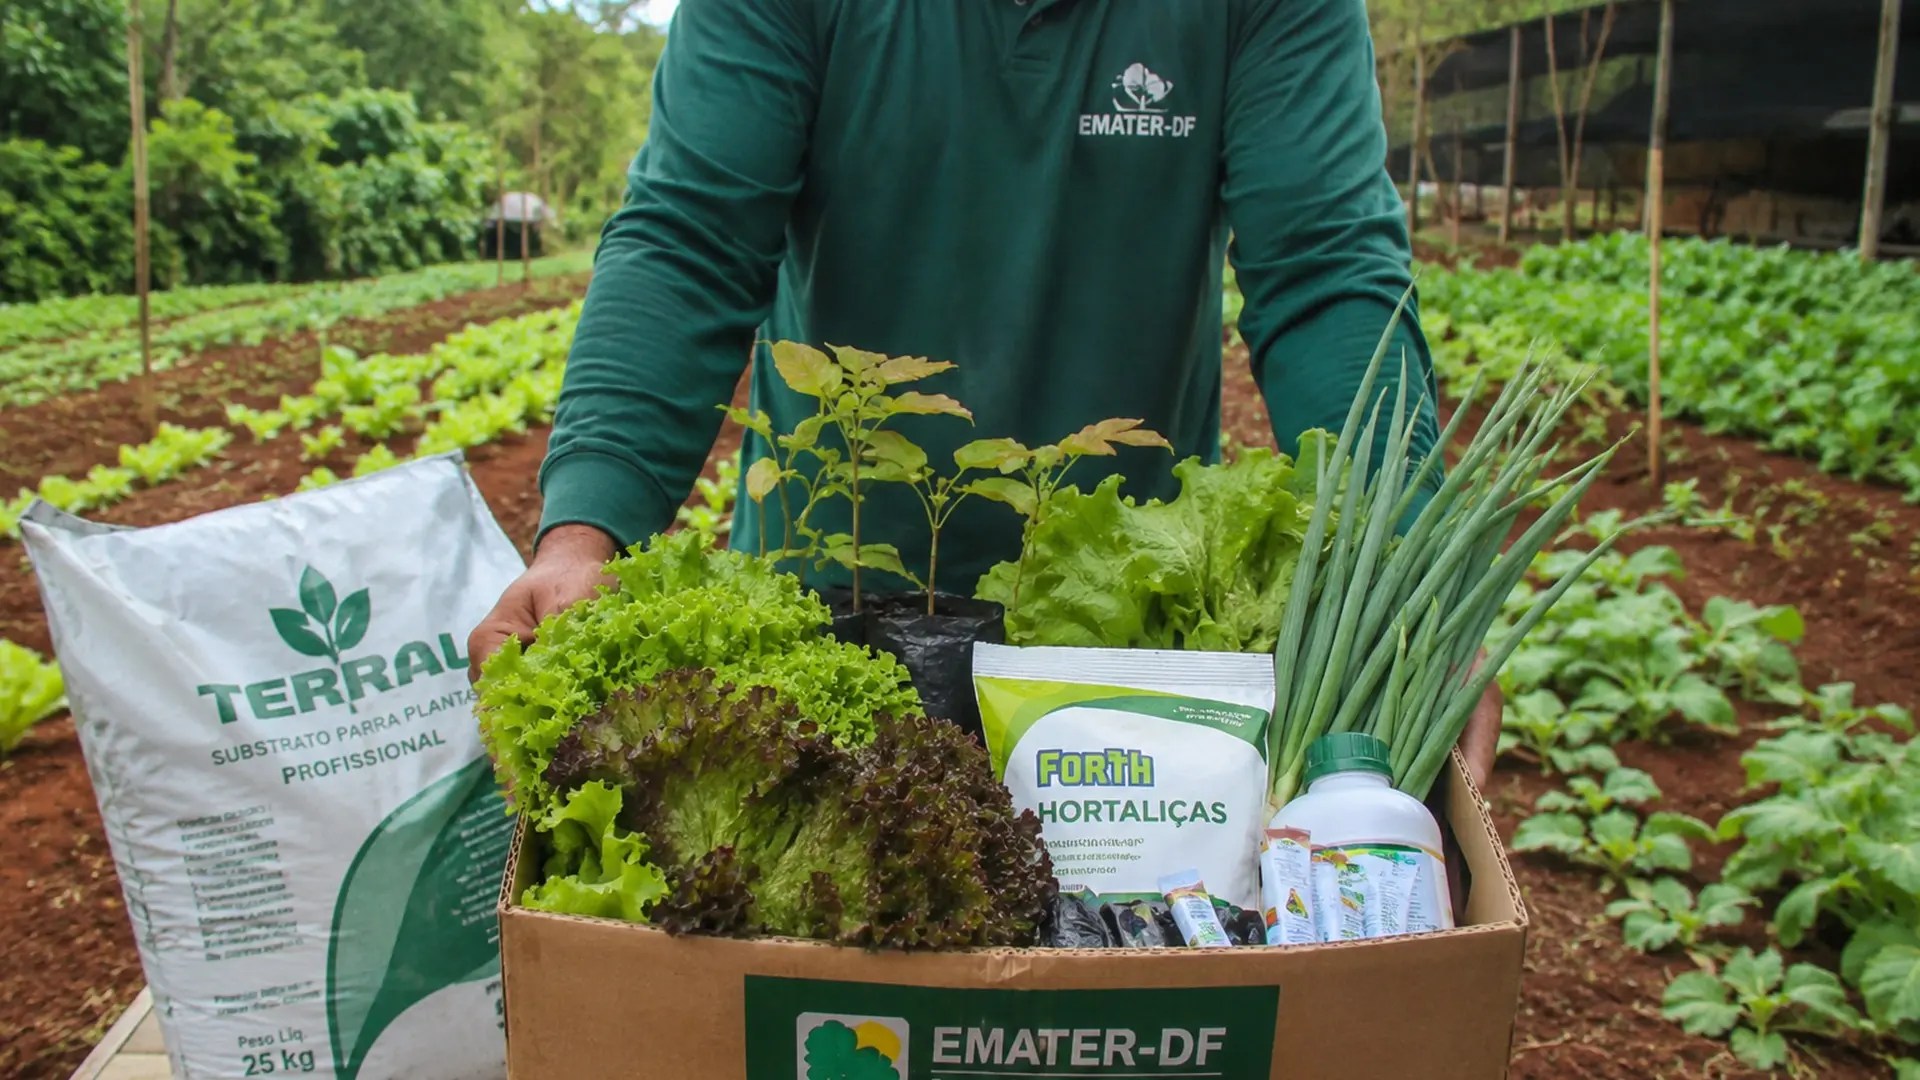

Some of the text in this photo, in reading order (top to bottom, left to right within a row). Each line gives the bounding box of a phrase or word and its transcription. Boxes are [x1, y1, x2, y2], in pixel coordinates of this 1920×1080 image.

[1079, 114, 1196, 137] EMATER-DF
[197, 633, 470, 724] TERRAL
[211, 730, 331, 766] SUBSTRATO
[336, 713, 400, 741] PARRA
[282, 729, 446, 784] PROFISSIONAL
[1037, 748, 1155, 788] FORTH
[1038, 800, 1228, 828] HORTALIÇAS
[238, 1036, 274, 1048] Peso
[932, 1027, 1227, 1066] EMATER-DF
[242, 1049, 315, 1077] 25 kg
